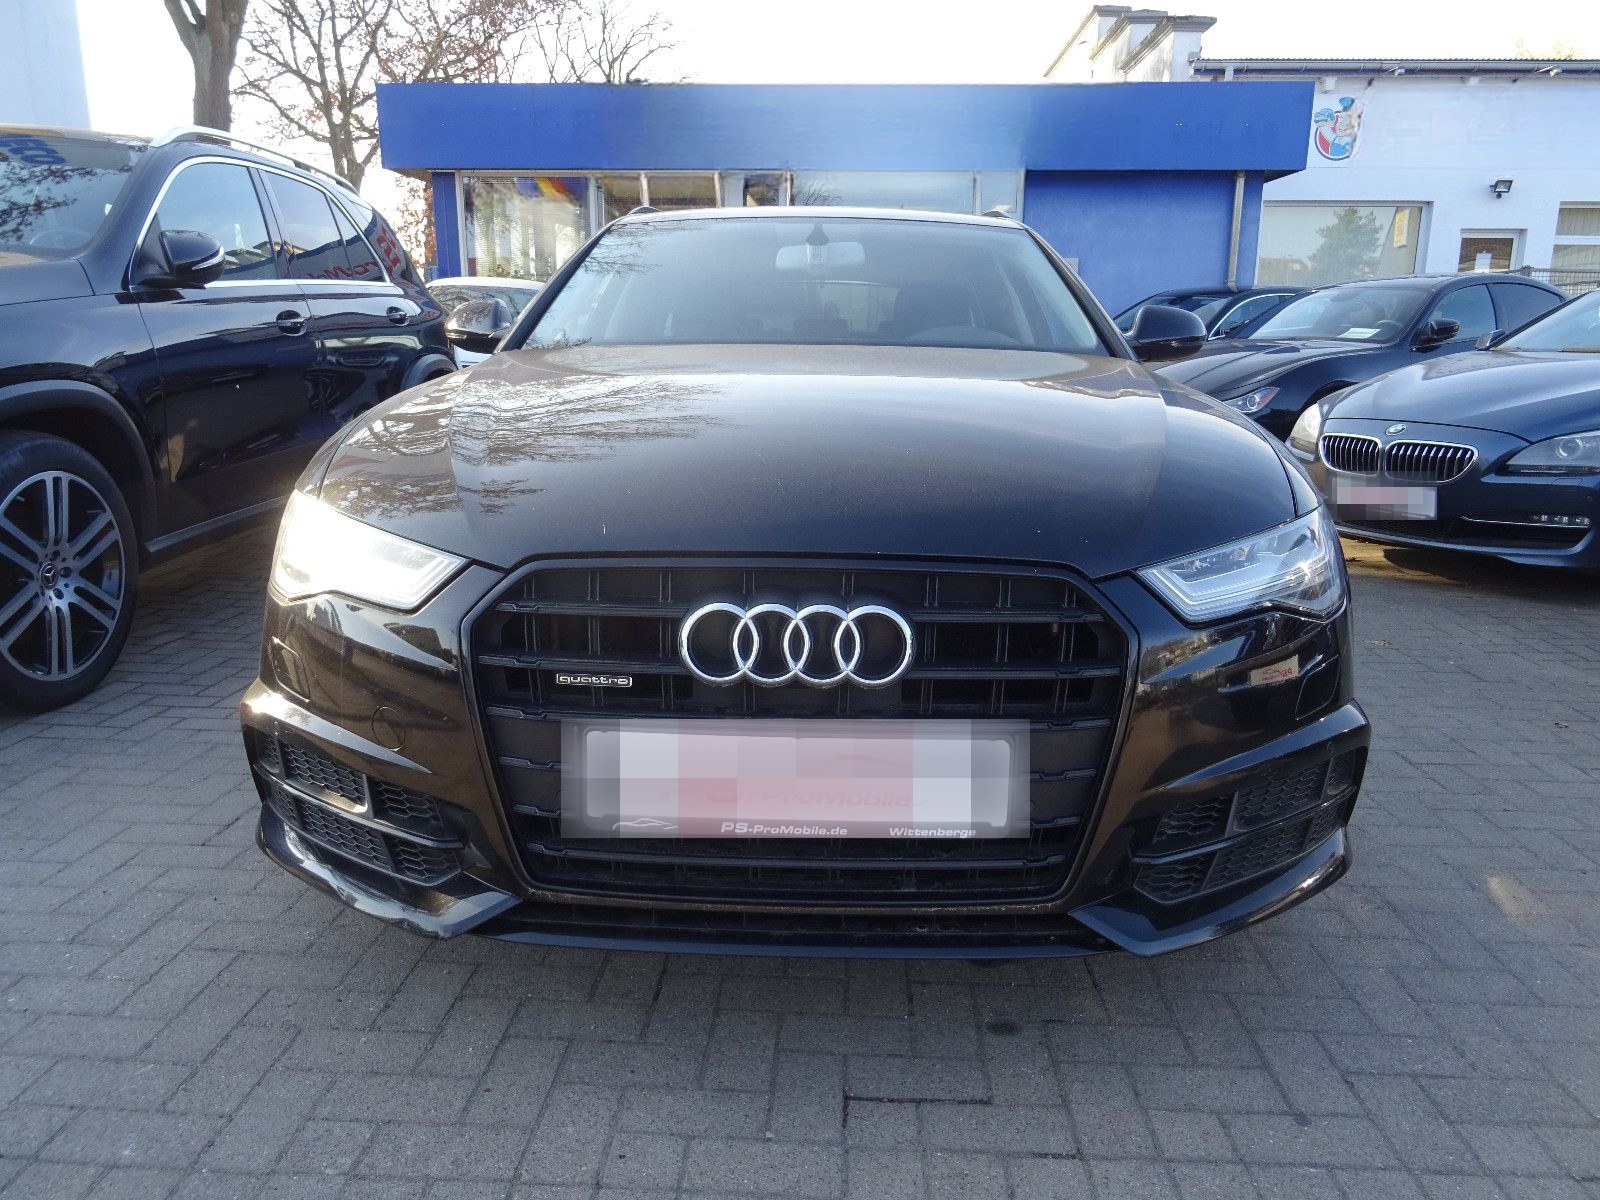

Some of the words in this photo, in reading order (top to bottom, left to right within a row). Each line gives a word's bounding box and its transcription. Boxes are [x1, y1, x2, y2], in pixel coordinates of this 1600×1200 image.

[559, 675, 629, 685] quattro
[720, 821, 848, 836] PS-ProMobile.de
[889, 827, 977, 838] Wittenberge
